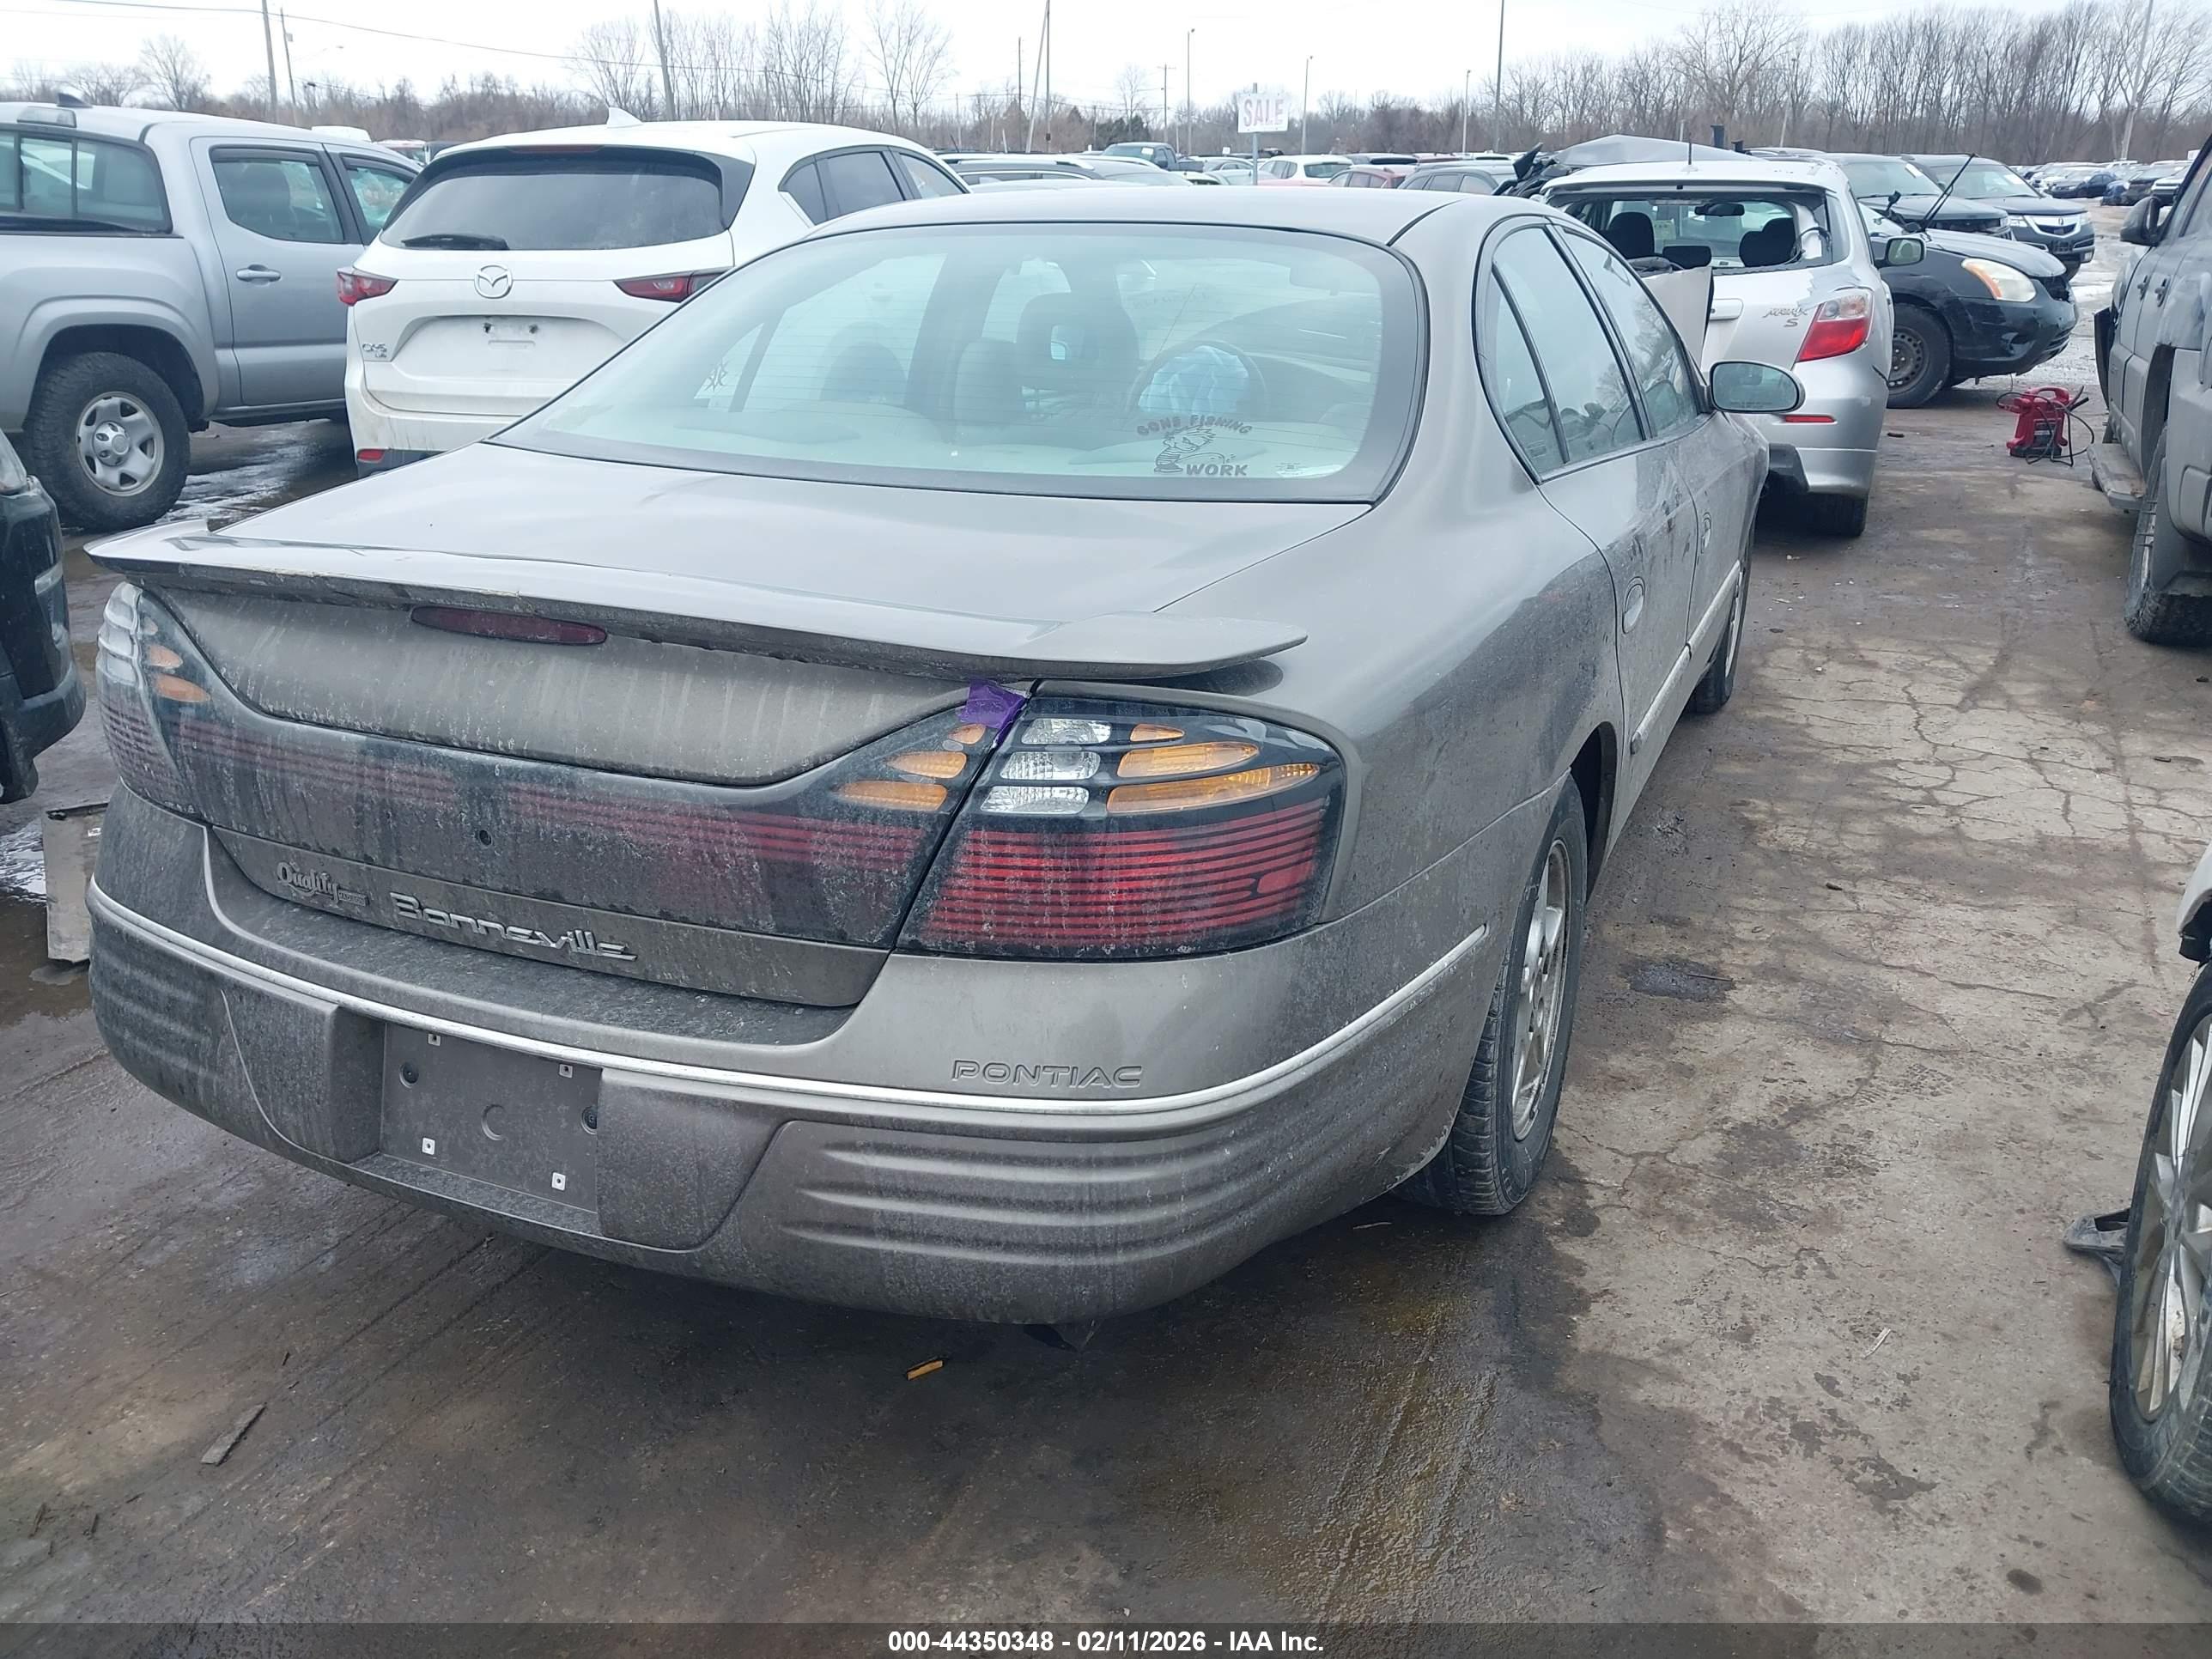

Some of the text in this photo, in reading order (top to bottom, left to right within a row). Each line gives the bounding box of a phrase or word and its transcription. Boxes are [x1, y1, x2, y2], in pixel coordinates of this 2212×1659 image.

[1243, 99, 1284, 126] SALE
[1784, 318, 1799, 327] S
[1136, 414, 1253, 435] GONE FISHING
[1186, 463, 1249, 477] WORK
[276, 859, 338, 903] Quality
[390, 891, 638, 962] Bonneville
[951, 1058, 1142, 1089] PONTIAC
